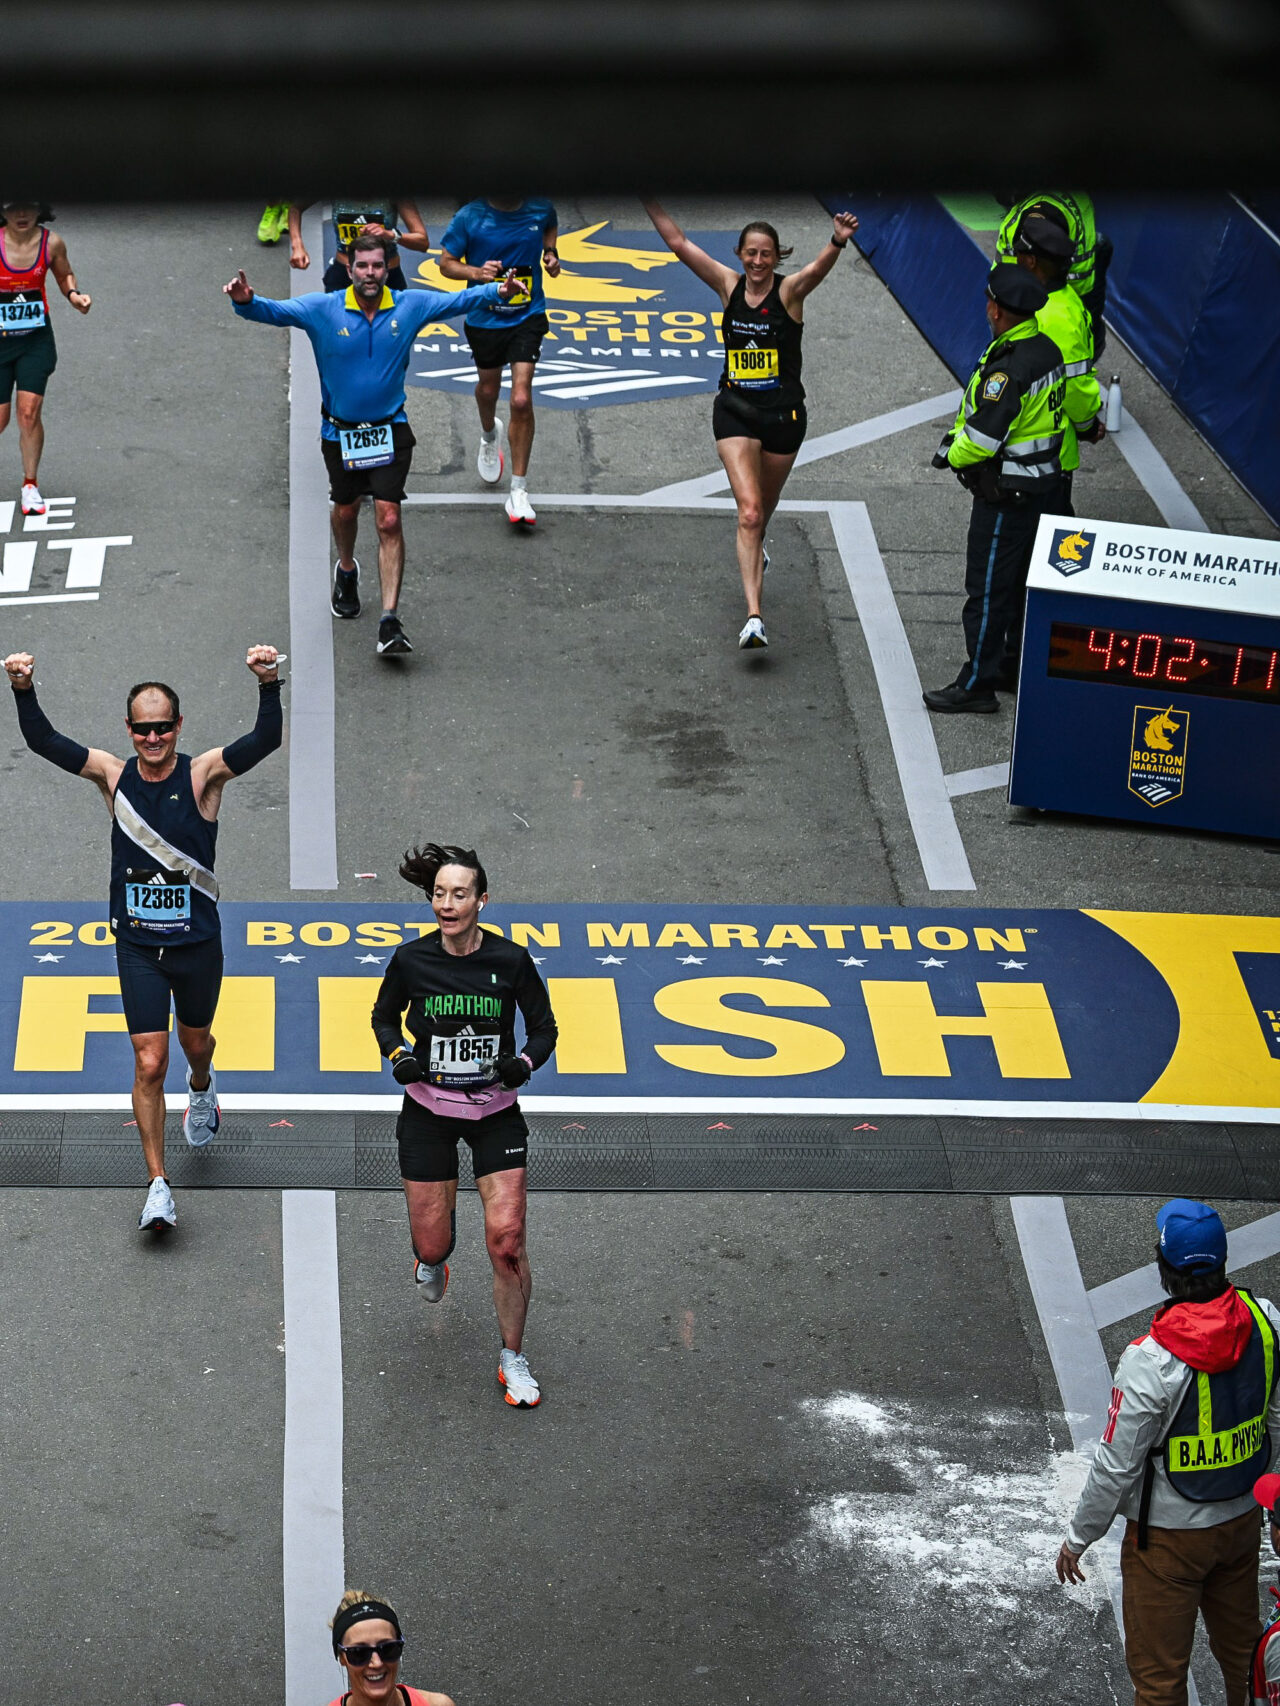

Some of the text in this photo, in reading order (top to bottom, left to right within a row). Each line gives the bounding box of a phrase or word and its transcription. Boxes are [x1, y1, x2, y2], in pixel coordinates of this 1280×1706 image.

[0, 303, 41, 322] 13744
[556, 347, 725, 358] AMERIC
[733, 351, 772, 370] 19081
[344, 427, 388, 450] 12632
[1105, 542, 1280, 577] BOSTON MARATH
[1102, 562, 1237, 587] BANK OF AMERICA
[1132, 762, 1182, 775] MARATHON
[1133, 750, 1183, 767] BOSTON
[1155, 775, 1181, 783] AMERICA
[131, 886, 185, 909] 12386
[246, 921, 561, 947] BOSN
[424, 994, 502, 1018] MARATHON
[437, 1037, 495, 1062] 11855
[1179, 1437, 1228, 1467] B.A.A.
